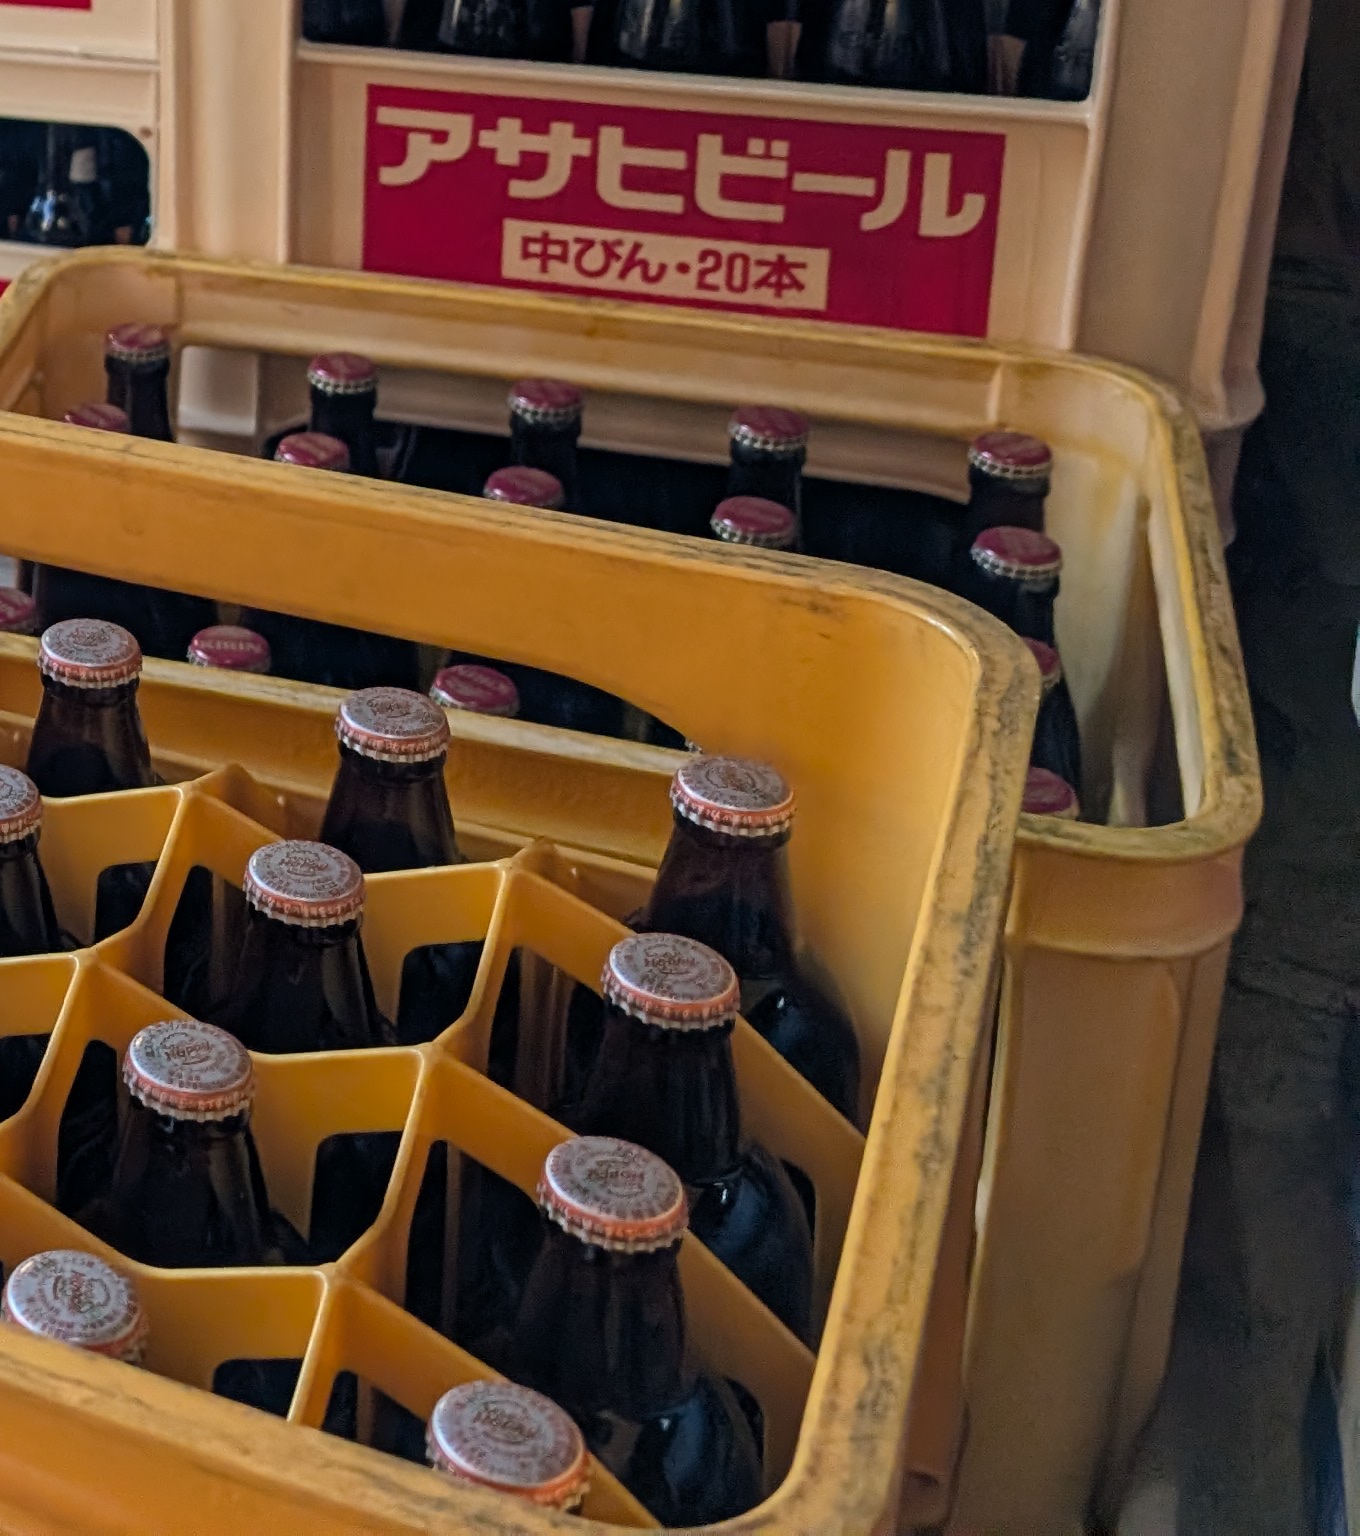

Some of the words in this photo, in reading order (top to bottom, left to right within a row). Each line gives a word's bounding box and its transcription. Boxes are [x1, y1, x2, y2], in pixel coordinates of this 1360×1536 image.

[375, 105, 987, 239] アサヒビール
[519, 230, 808, 299] 中びん・20本
